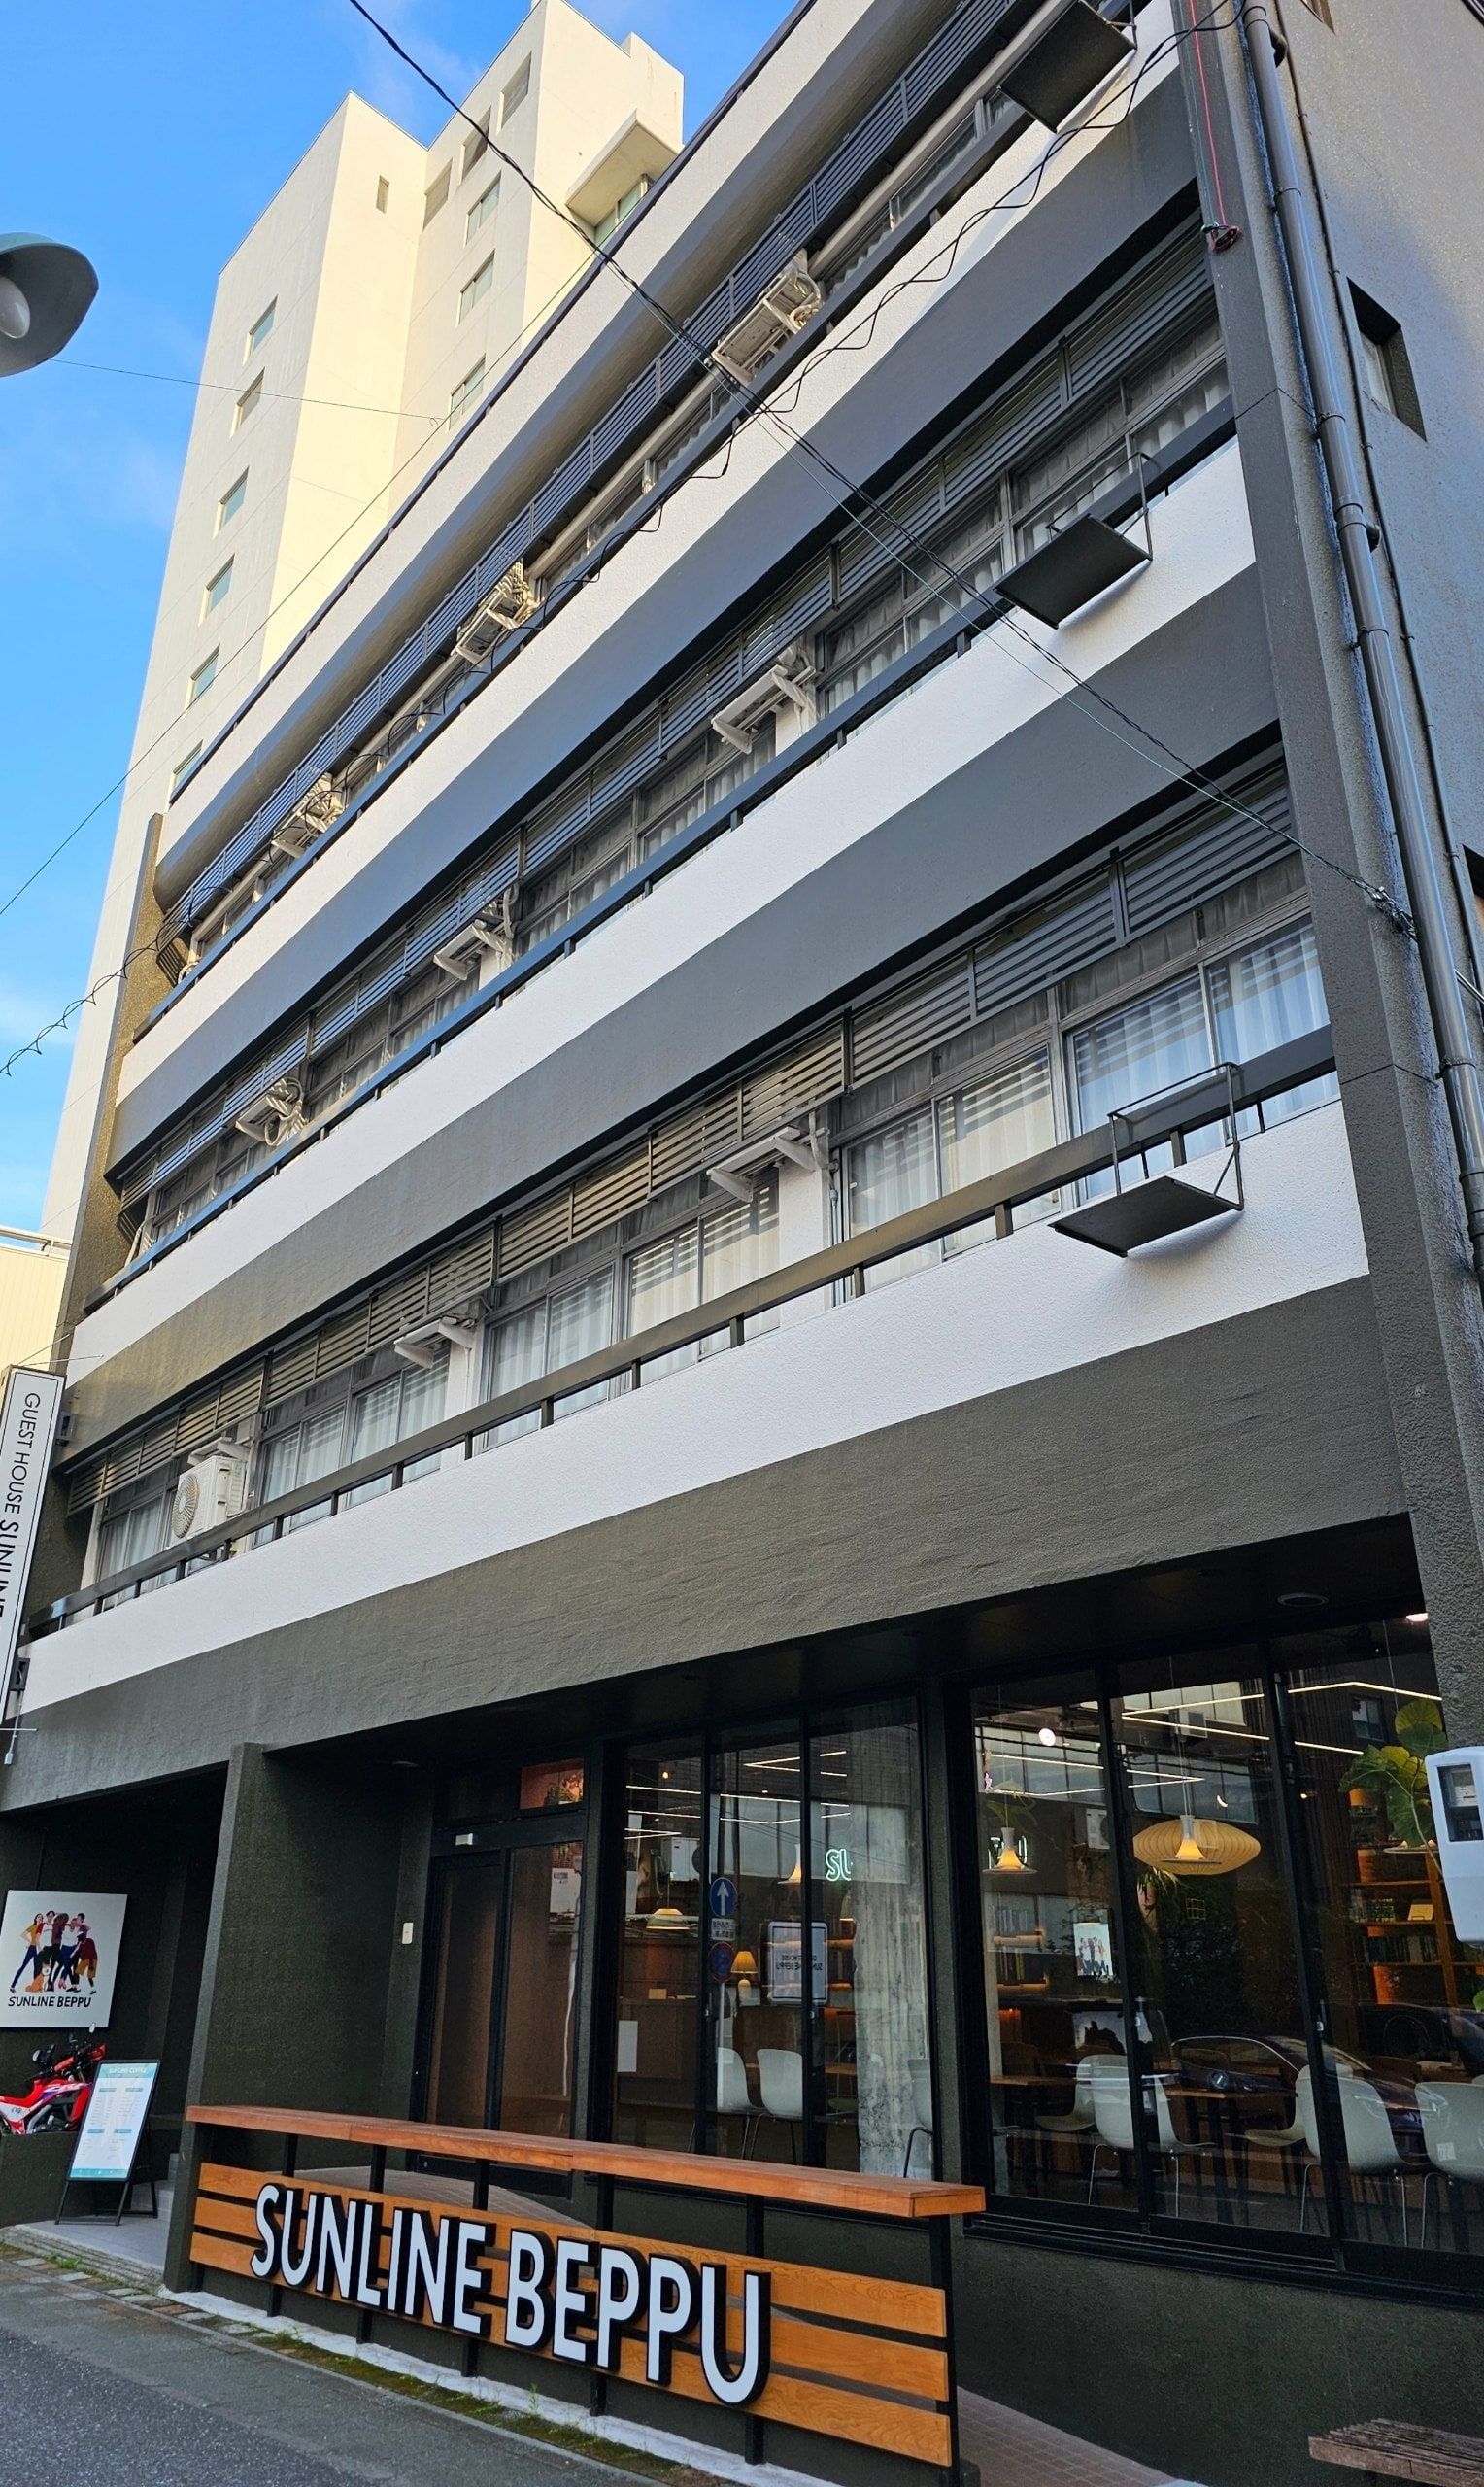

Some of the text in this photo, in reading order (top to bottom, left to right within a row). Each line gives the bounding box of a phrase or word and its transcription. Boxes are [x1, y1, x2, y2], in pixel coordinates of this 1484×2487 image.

[17, 1392, 41, 1448] GUEST
[5, 1451, 30, 1515] HOUSE
[8, 1996, 91, 2008] SUNLINE BEPPU
[250, 2183, 769, 2405] SUNLINE BEPPU
